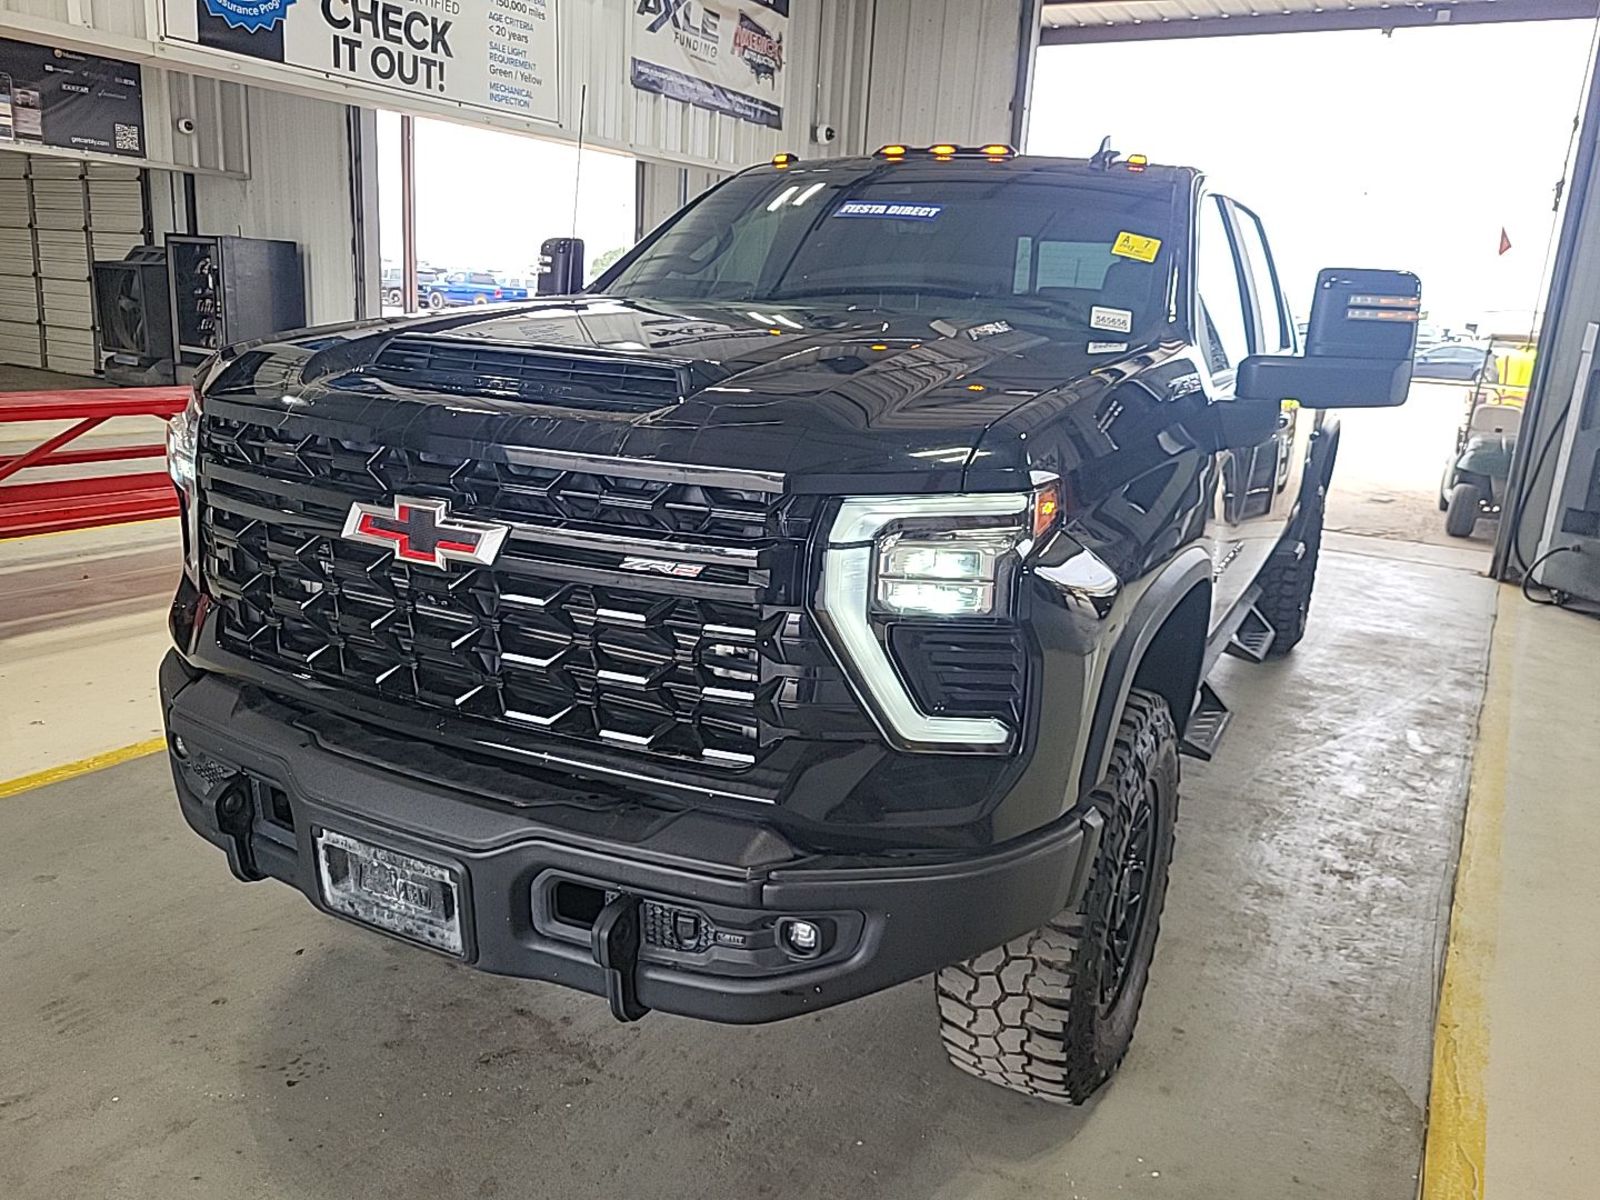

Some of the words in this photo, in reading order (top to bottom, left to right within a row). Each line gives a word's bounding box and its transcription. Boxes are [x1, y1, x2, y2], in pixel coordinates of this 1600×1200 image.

[489, 11, 504, 23] AGE
[504, 16, 534, 31] CRITERIA
[529, 7, 546, 20] miles
[321, 0, 453, 58] CHECK
[496, 25, 507, 37] 20
[508, 31, 529, 43] years
[489, 41, 506, 53] SALE
[507, 46, 527, 58] LIGHT
[674, 31, 718, 58] FUNDING
[333, 35, 362, 72] IT
[371, 46, 445, 93] OUT!
[489, 52, 537, 71] REQUIREMENT
[489, 64, 513, 79] Green
[519, 70, 543, 86] Yellow
[489, 81, 534, 99] MECHANICAL
[489, 93, 530, 108] INSPECTION
[840, 204, 887, 215] FIESTA
[886, 205, 941, 218] DIRECT
